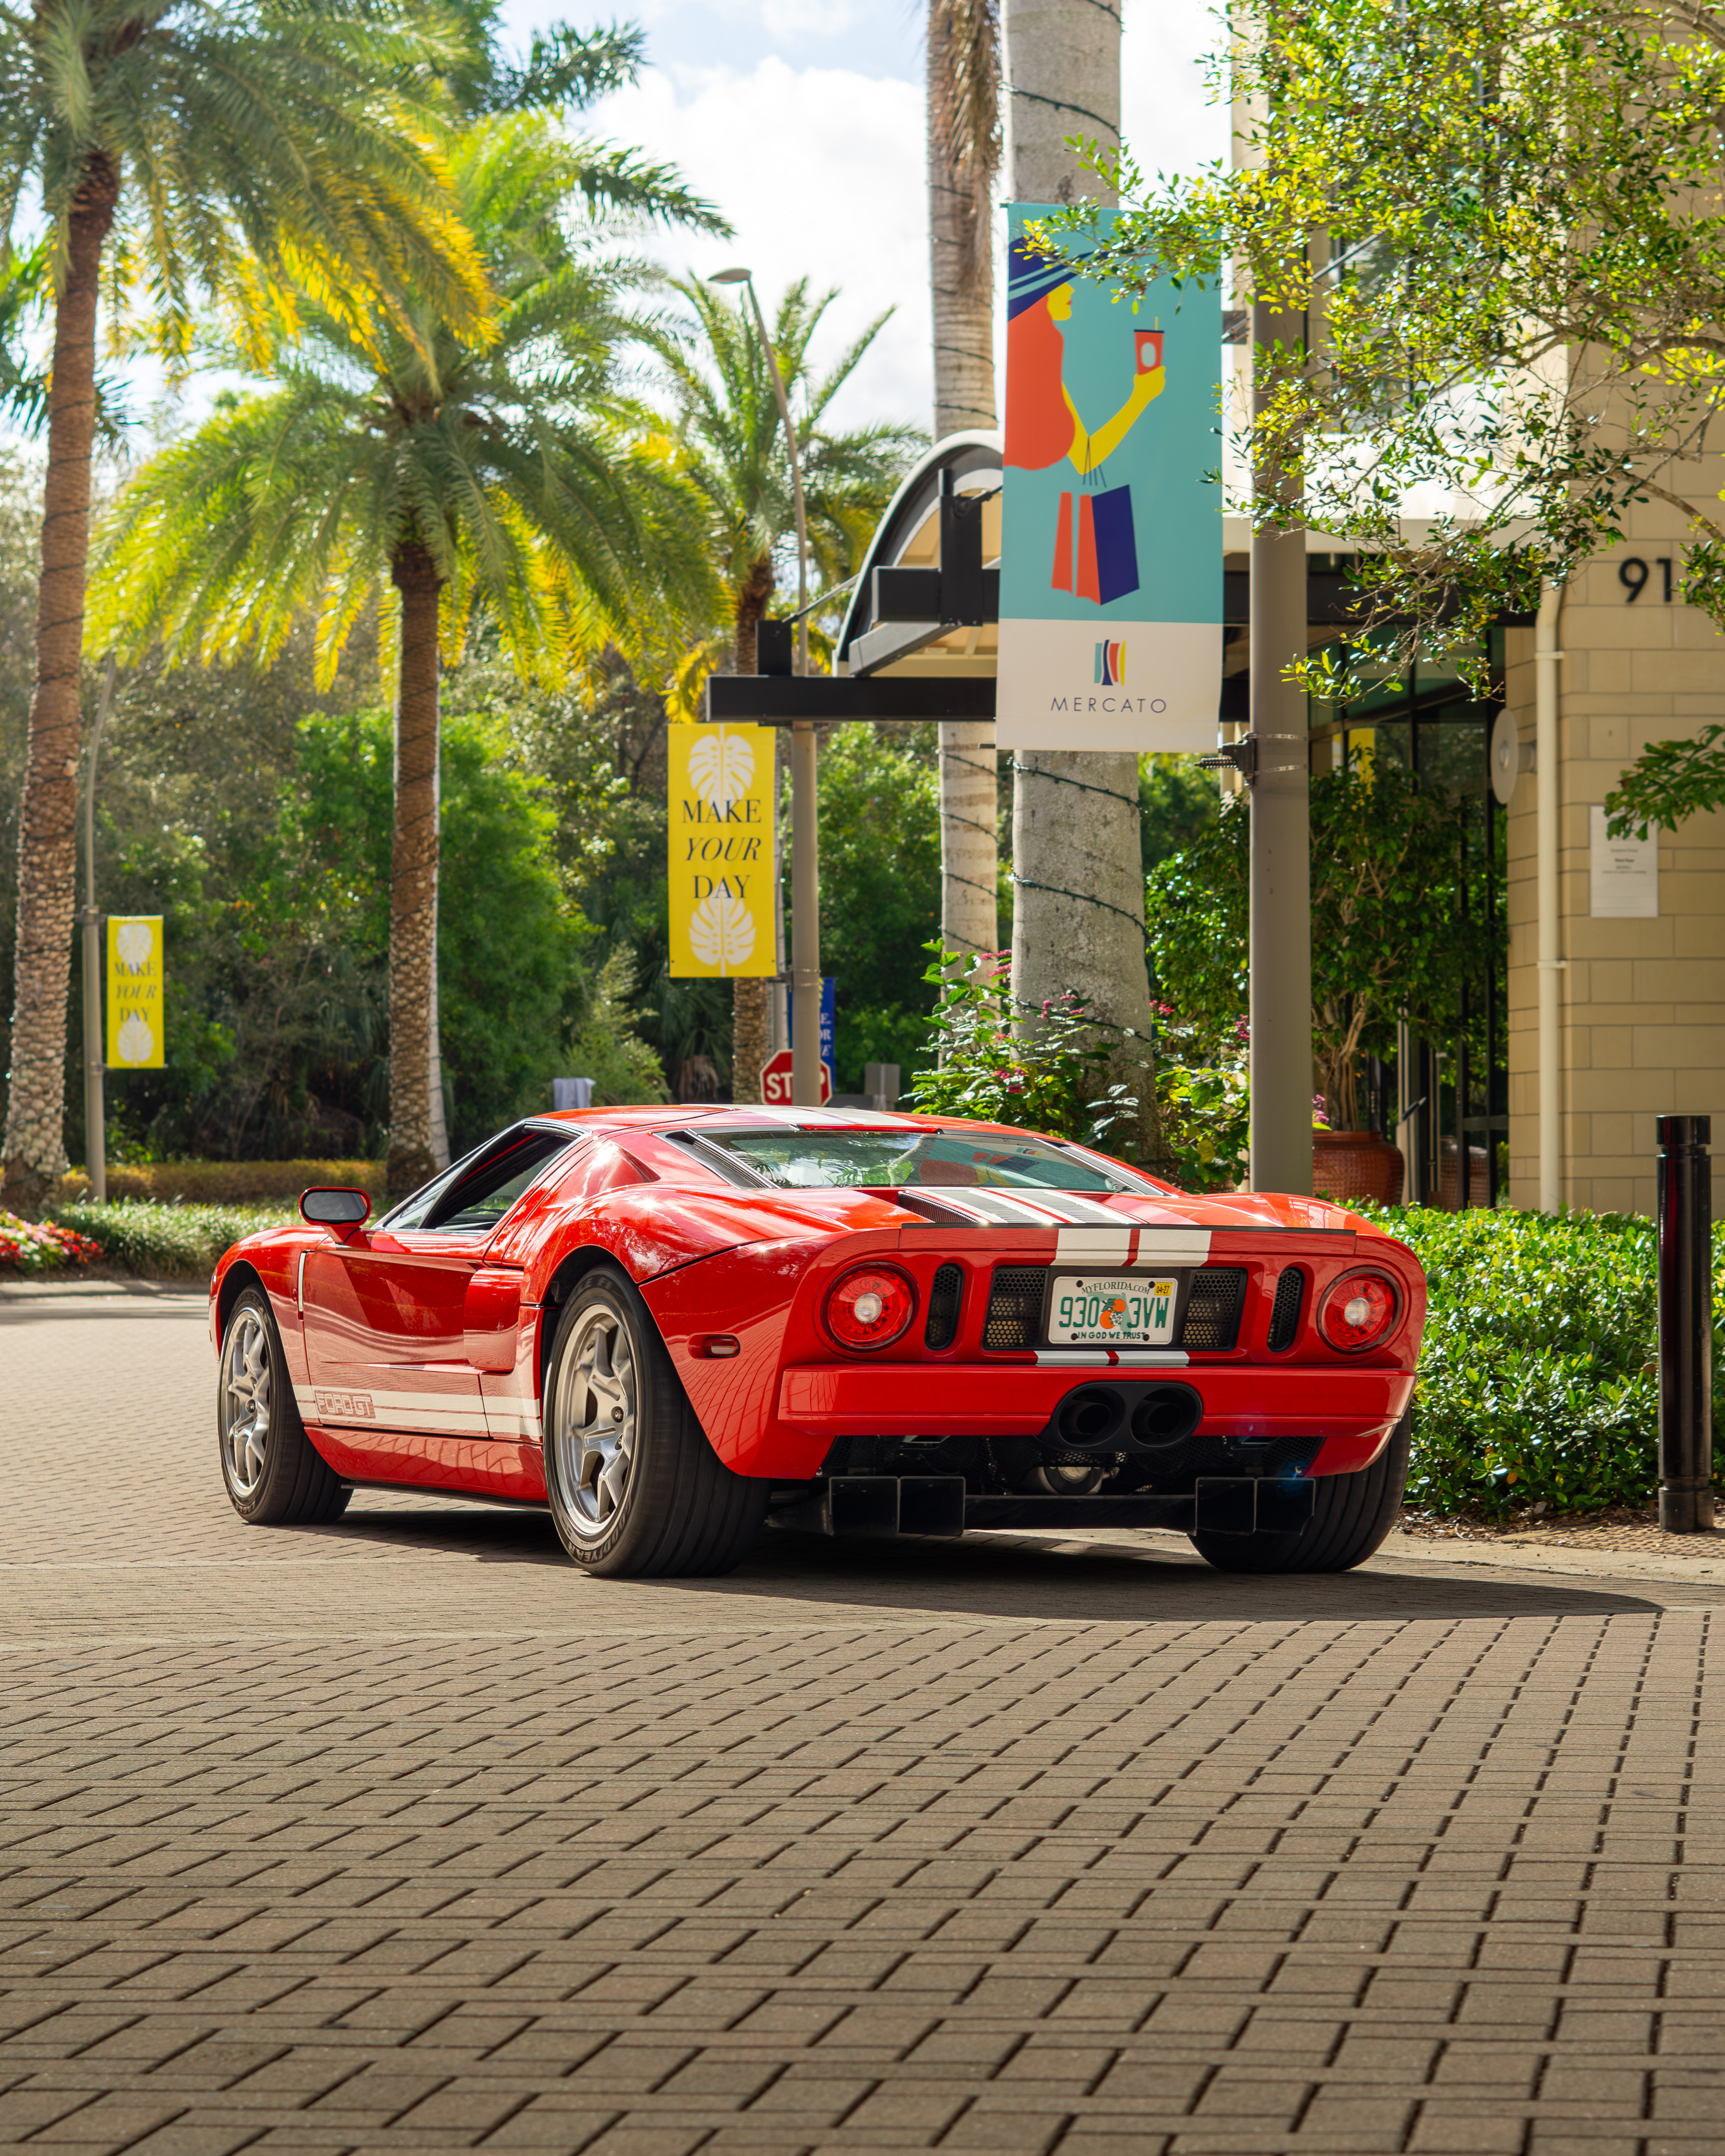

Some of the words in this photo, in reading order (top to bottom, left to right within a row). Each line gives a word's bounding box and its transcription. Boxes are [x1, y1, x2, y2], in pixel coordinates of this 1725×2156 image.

[1051, 697, 1166, 713] MERCATO
[681, 800, 761, 823] MAKE
[684, 837, 761, 861] YOUR
[693, 875, 751, 899] DAY
[114, 962, 157, 977] MAKE
[116, 984, 157, 999] YOUR
[120, 1007, 150, 1022] DAY
[1082, 1281, 1150, 1294] MYFLORIDA.COM
[1059, 1297, 1099, 1327] 930
[1127, 1298, 1169, 1327] 3VW
[316, 1393, 353, 1414] FORD
[353, 1396, 371, 1415] GT
